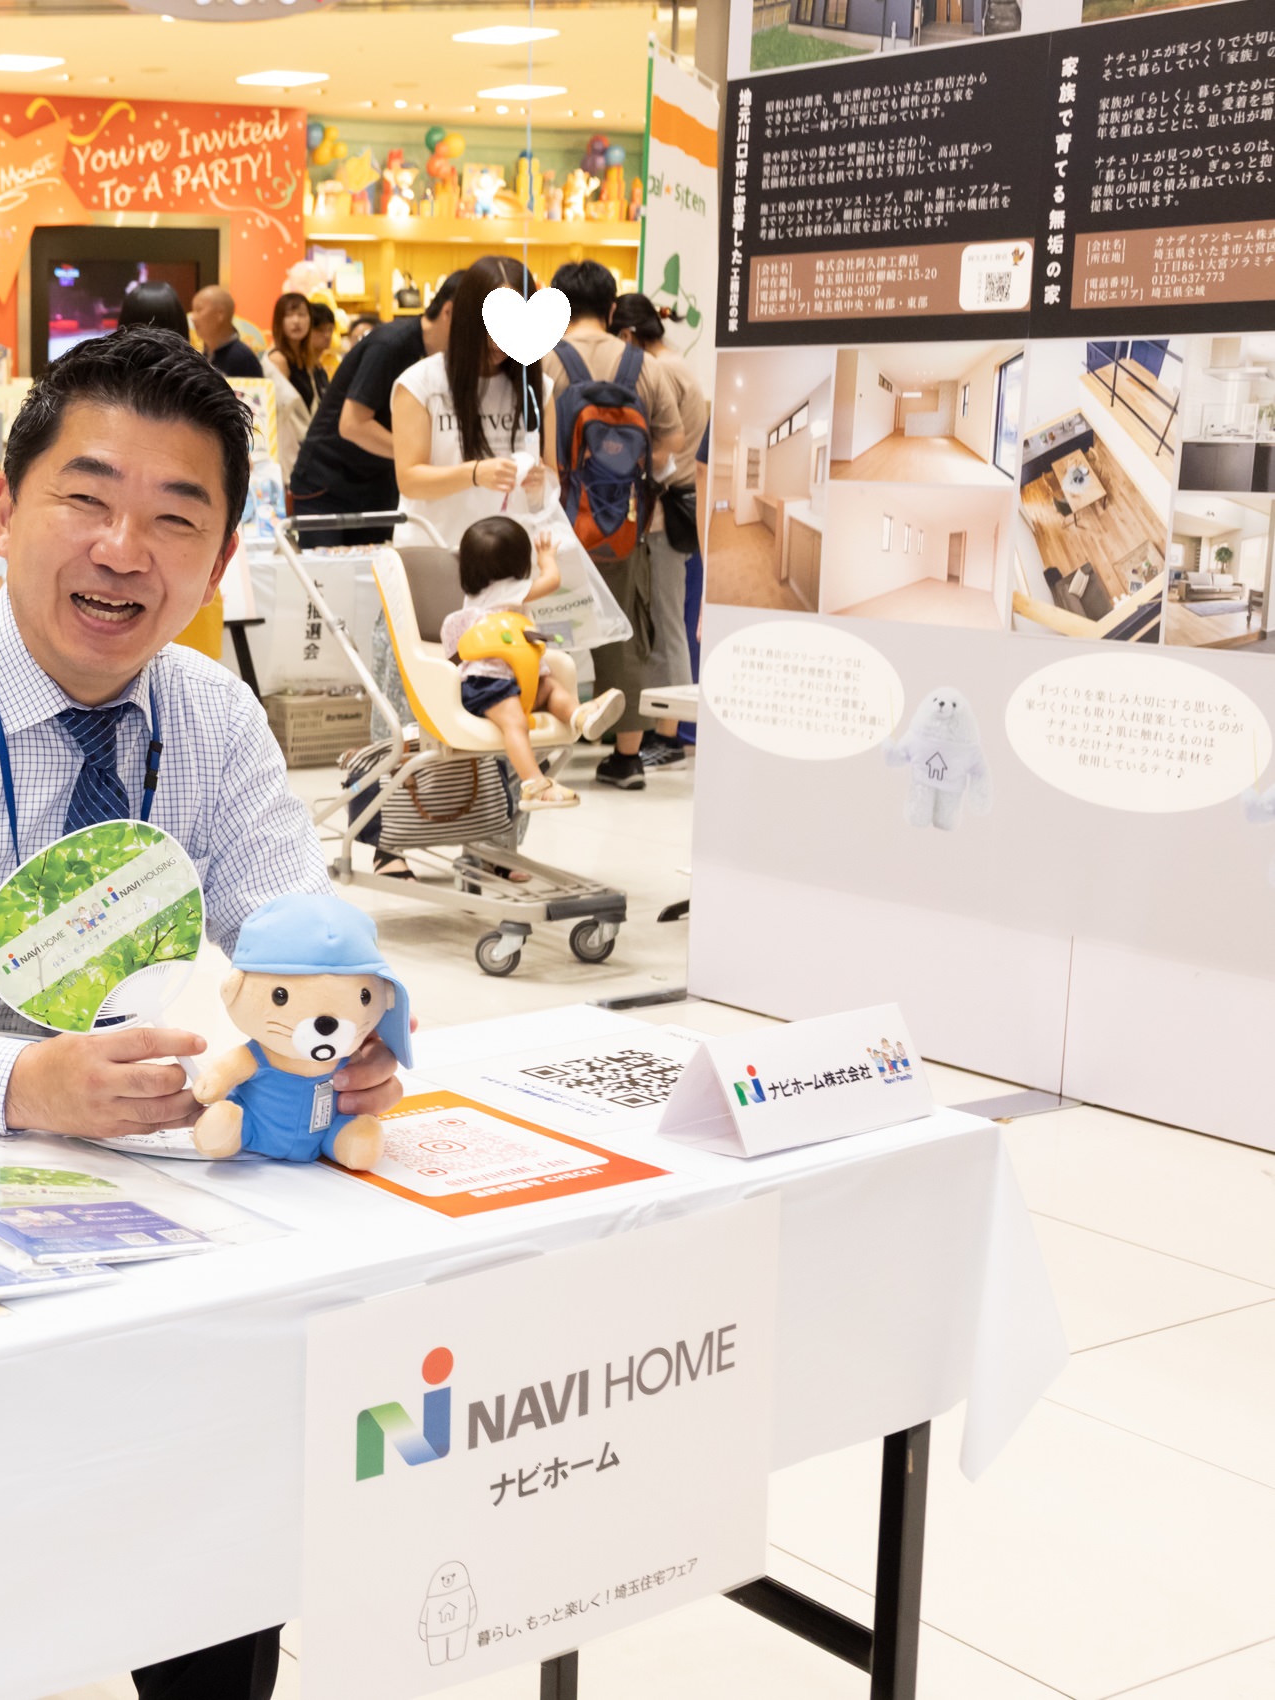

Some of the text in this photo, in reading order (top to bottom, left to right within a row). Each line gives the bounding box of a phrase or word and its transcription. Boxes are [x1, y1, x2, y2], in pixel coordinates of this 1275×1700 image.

[72, 108, 289, 175] You're Invited
[1094, 139, 1275, 169] ナチュリエが見つめているのは、
[98, 150, 273, 209] To A PARTY!
[1043, 56, 1079, 305] 家族で育てる無垢の家
[1090, 193, 1180, 214] 提案しています。
[814, 284, 882, 299] 048-268-0507
[1151, 271, 1225, 286] 0120-637-773
[1151, 284, 1206, 300] 埼玉県全域
[119, 856, 177, 899] NAVI HOUSING
[19, 929, 67, 964] NAVI HOME
[768, 1062, 874, 1101] ナビホーム株式会社
[467, 1323, 738, 1450] NAVI HOME
[489, 1441, 620, 1507] ナビホーム
